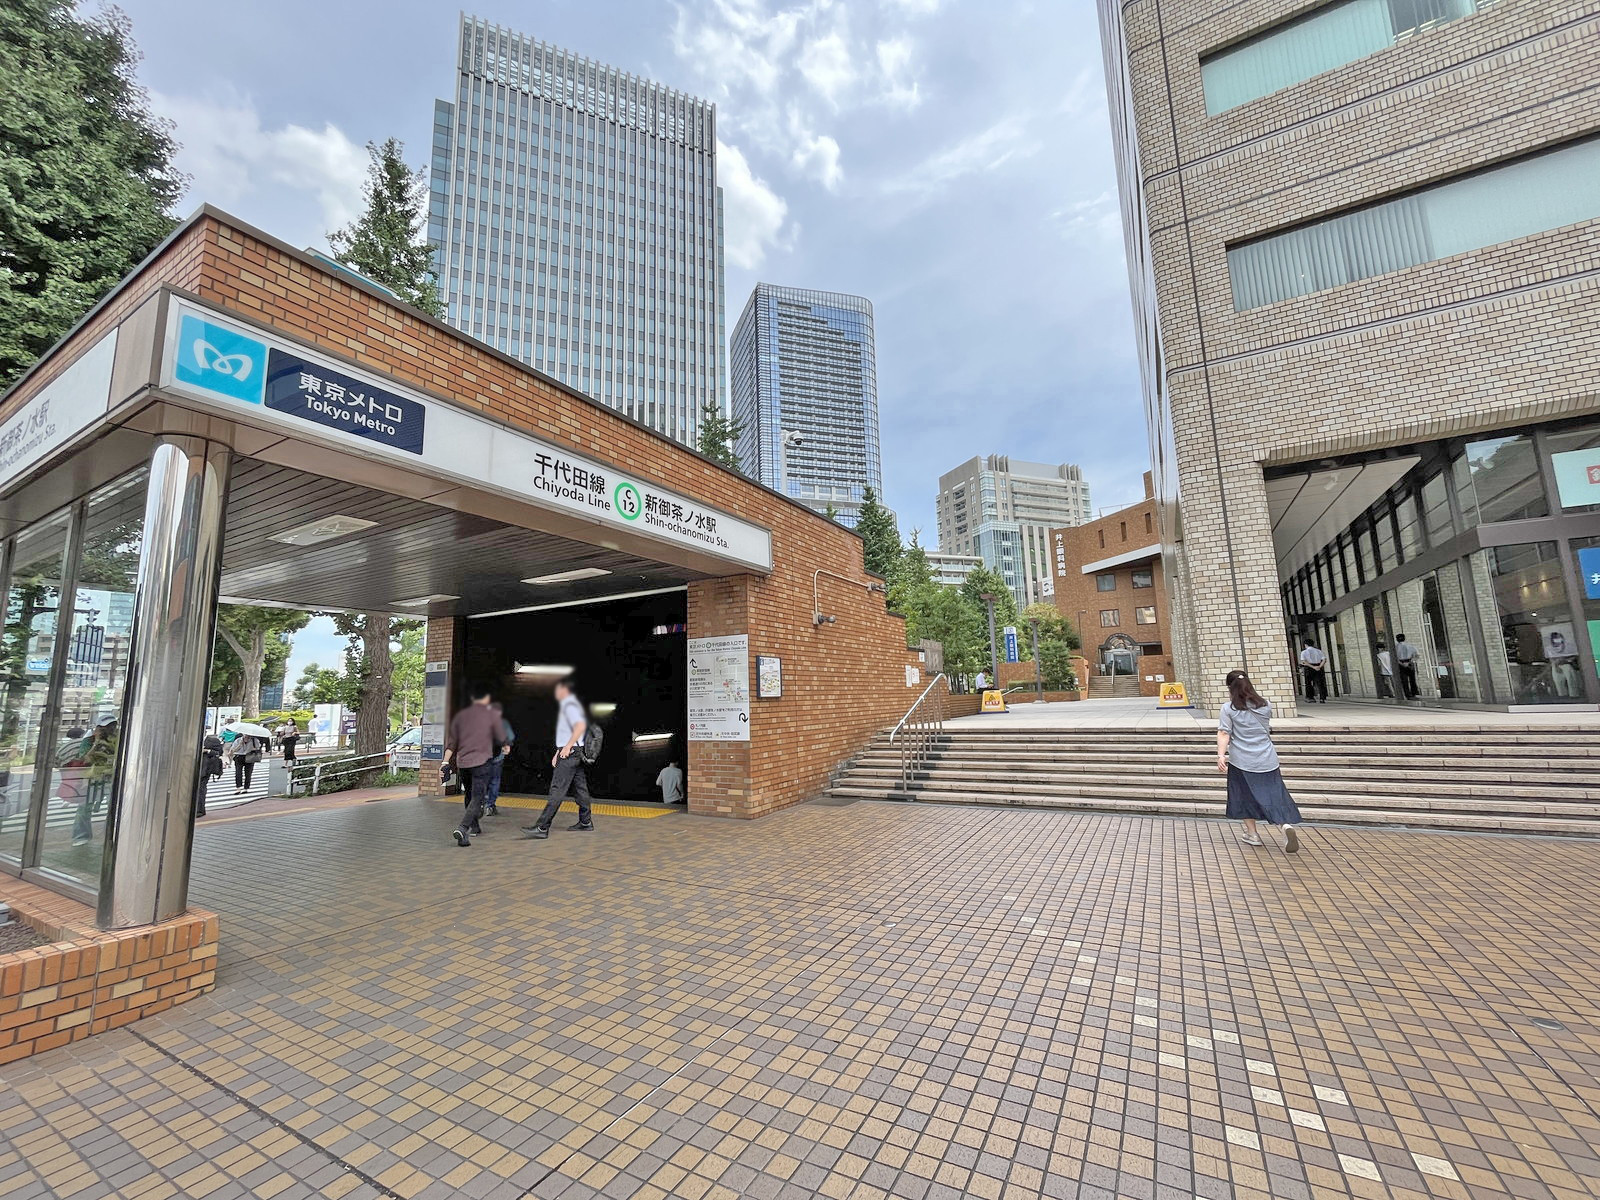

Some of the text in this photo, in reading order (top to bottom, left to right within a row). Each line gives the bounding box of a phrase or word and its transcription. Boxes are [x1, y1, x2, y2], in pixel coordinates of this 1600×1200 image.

[298, 371, 402, 423] 東京メトロ
[304, 394, 396, 436] Tokyo Metro
[533, 452, 606, 495] 千代田線
[533, 475, 611, 511] Chiyoda Line
[622, 499, 635, 513] 12
[625, 489, 632, 500] C
[645, 493, 717, 533] 新御茶ノ水駅
[645, 512, 730, 549] Shin-ochanomizu Sta.
